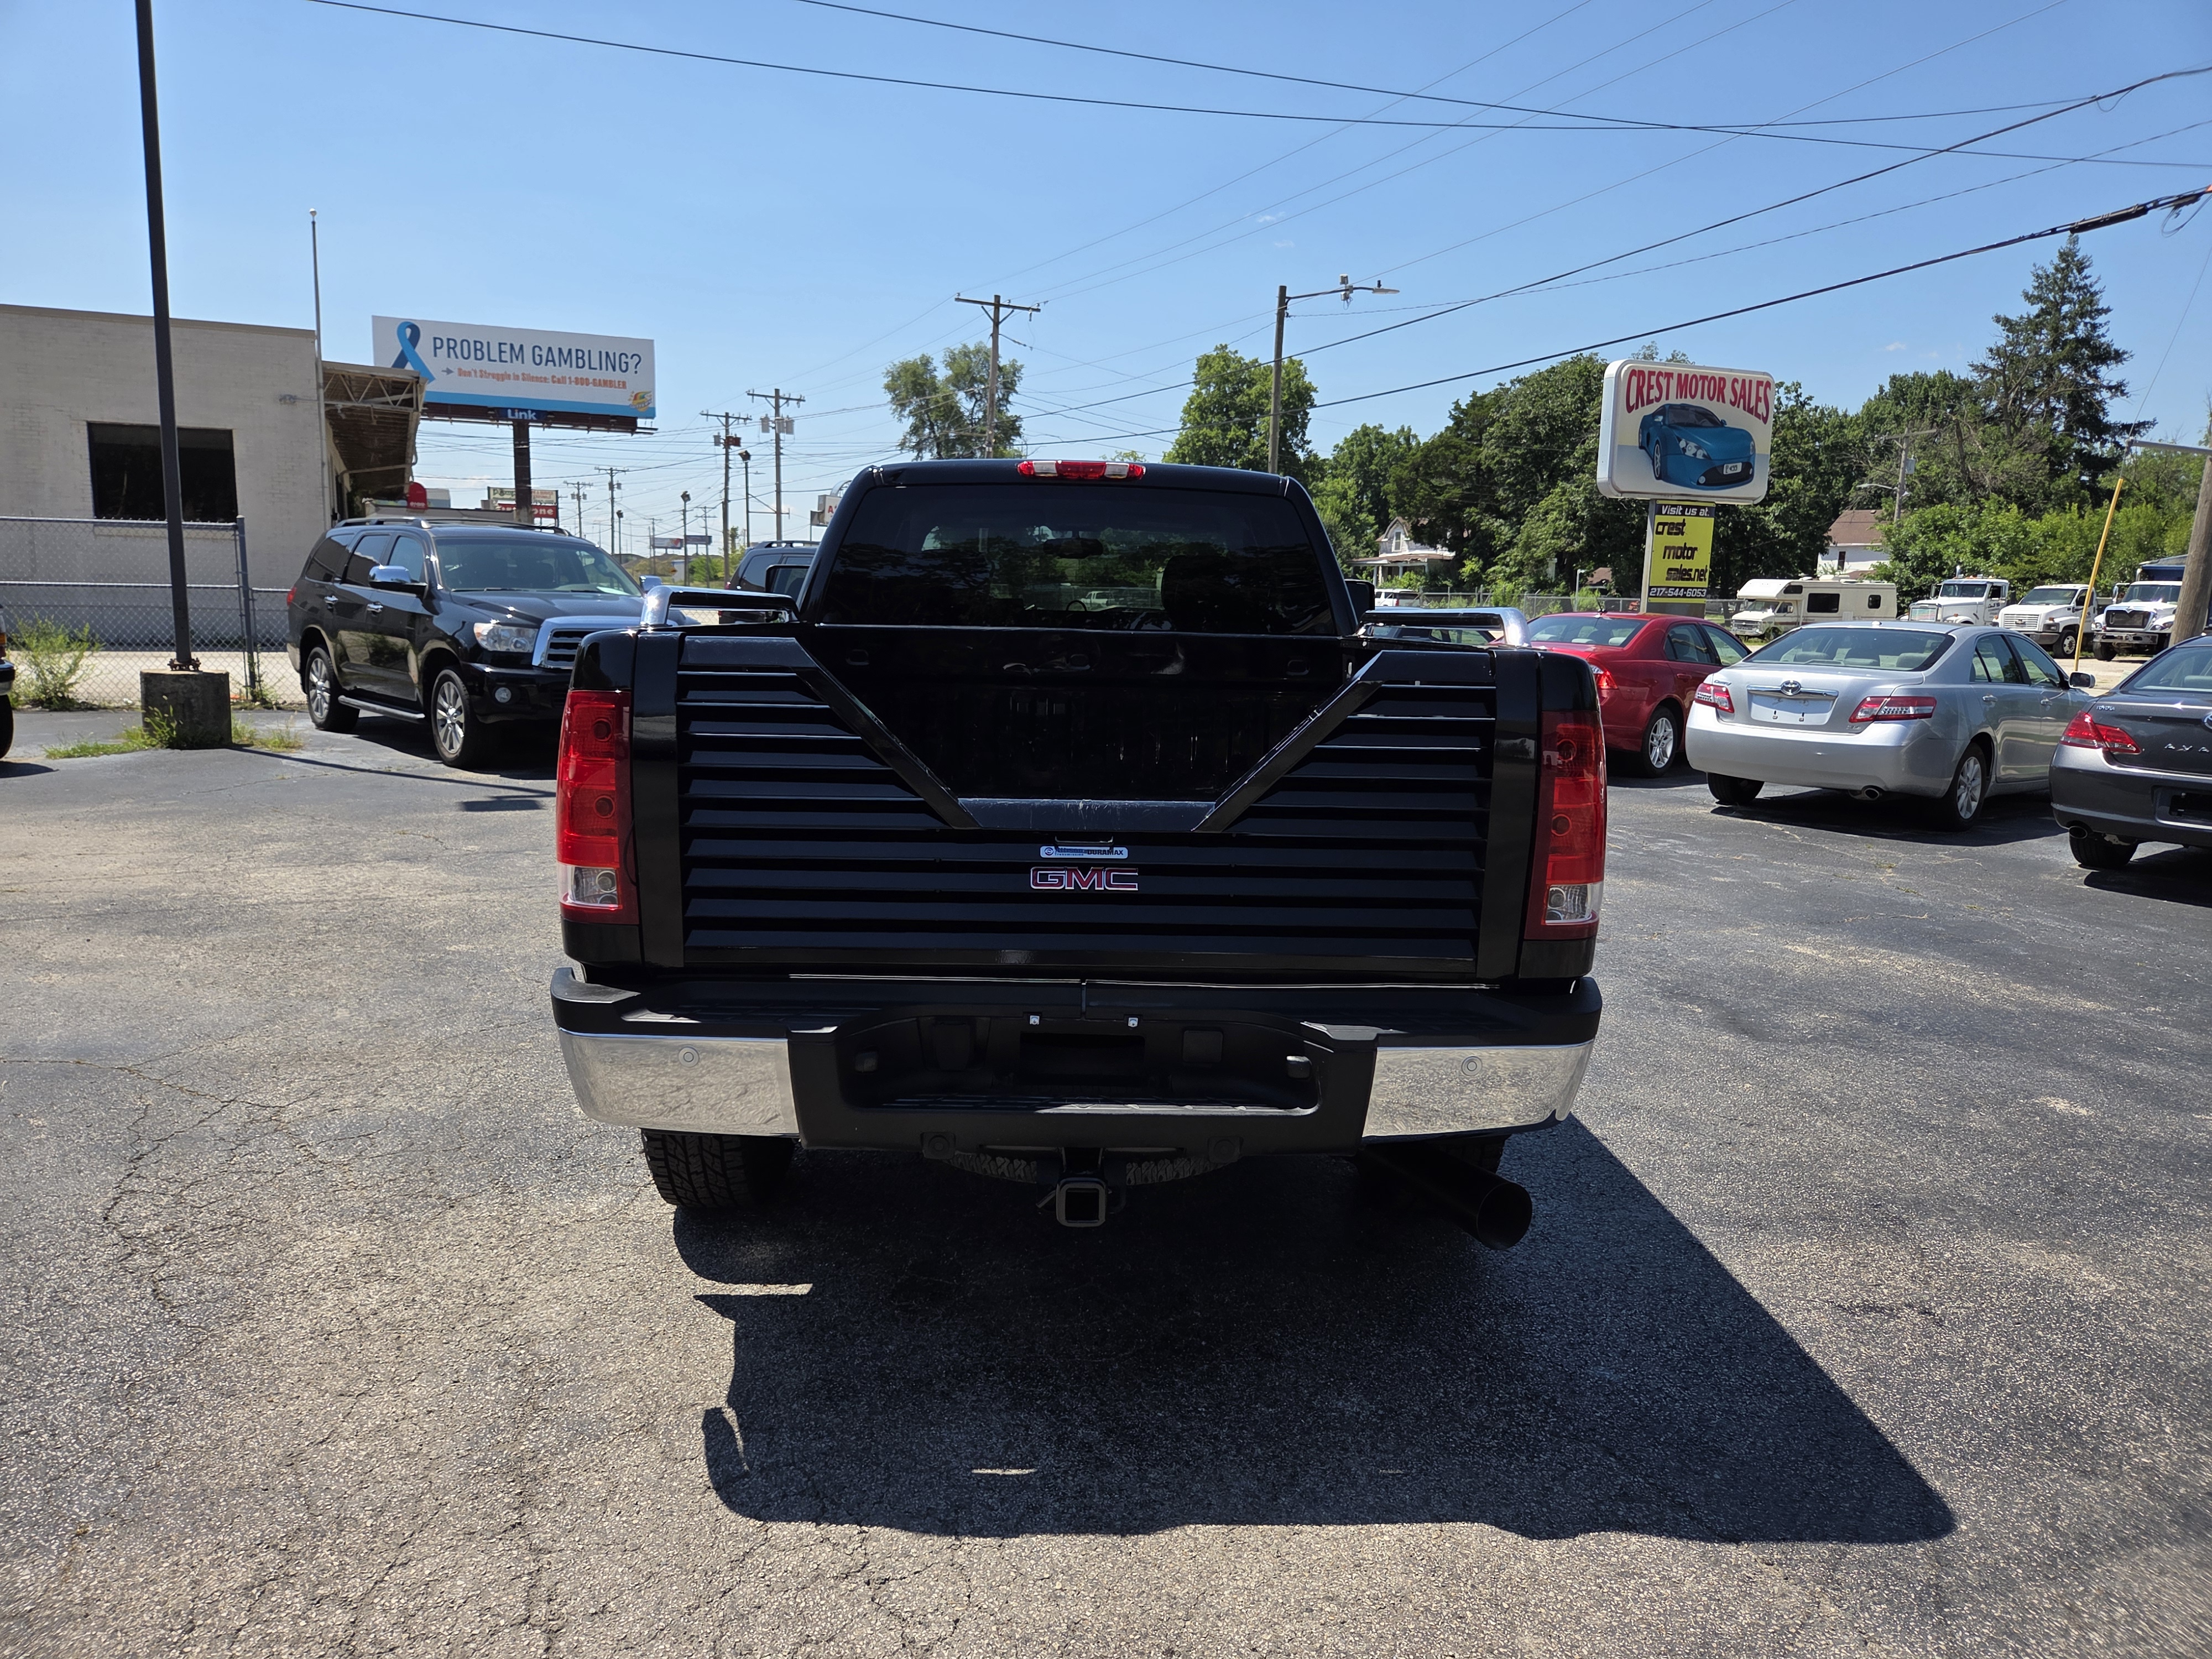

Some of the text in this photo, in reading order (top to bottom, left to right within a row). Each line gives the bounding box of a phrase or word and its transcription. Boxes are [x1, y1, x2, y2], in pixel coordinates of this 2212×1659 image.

[433, 337, 641, 374] PROBLEM GAMBLING?
[551, 374, 567, 384] Call
[568, 376, 627, 389] 1-800-GAMBLER
[1626, 369, 1772, 425] CREST MOTOR SALES
[507, 409, 537, 420] Link
[1661, 505, 1682, 515] Visit
[1655, 518, 1686, 536] crest
[1663, 542, 1698, 560] motor
[1666, 564, 1708, 582] sales.net
[1650, 588, 1707, 597] 217-544-6053
[1030, 867, 1139, 891] GMC
